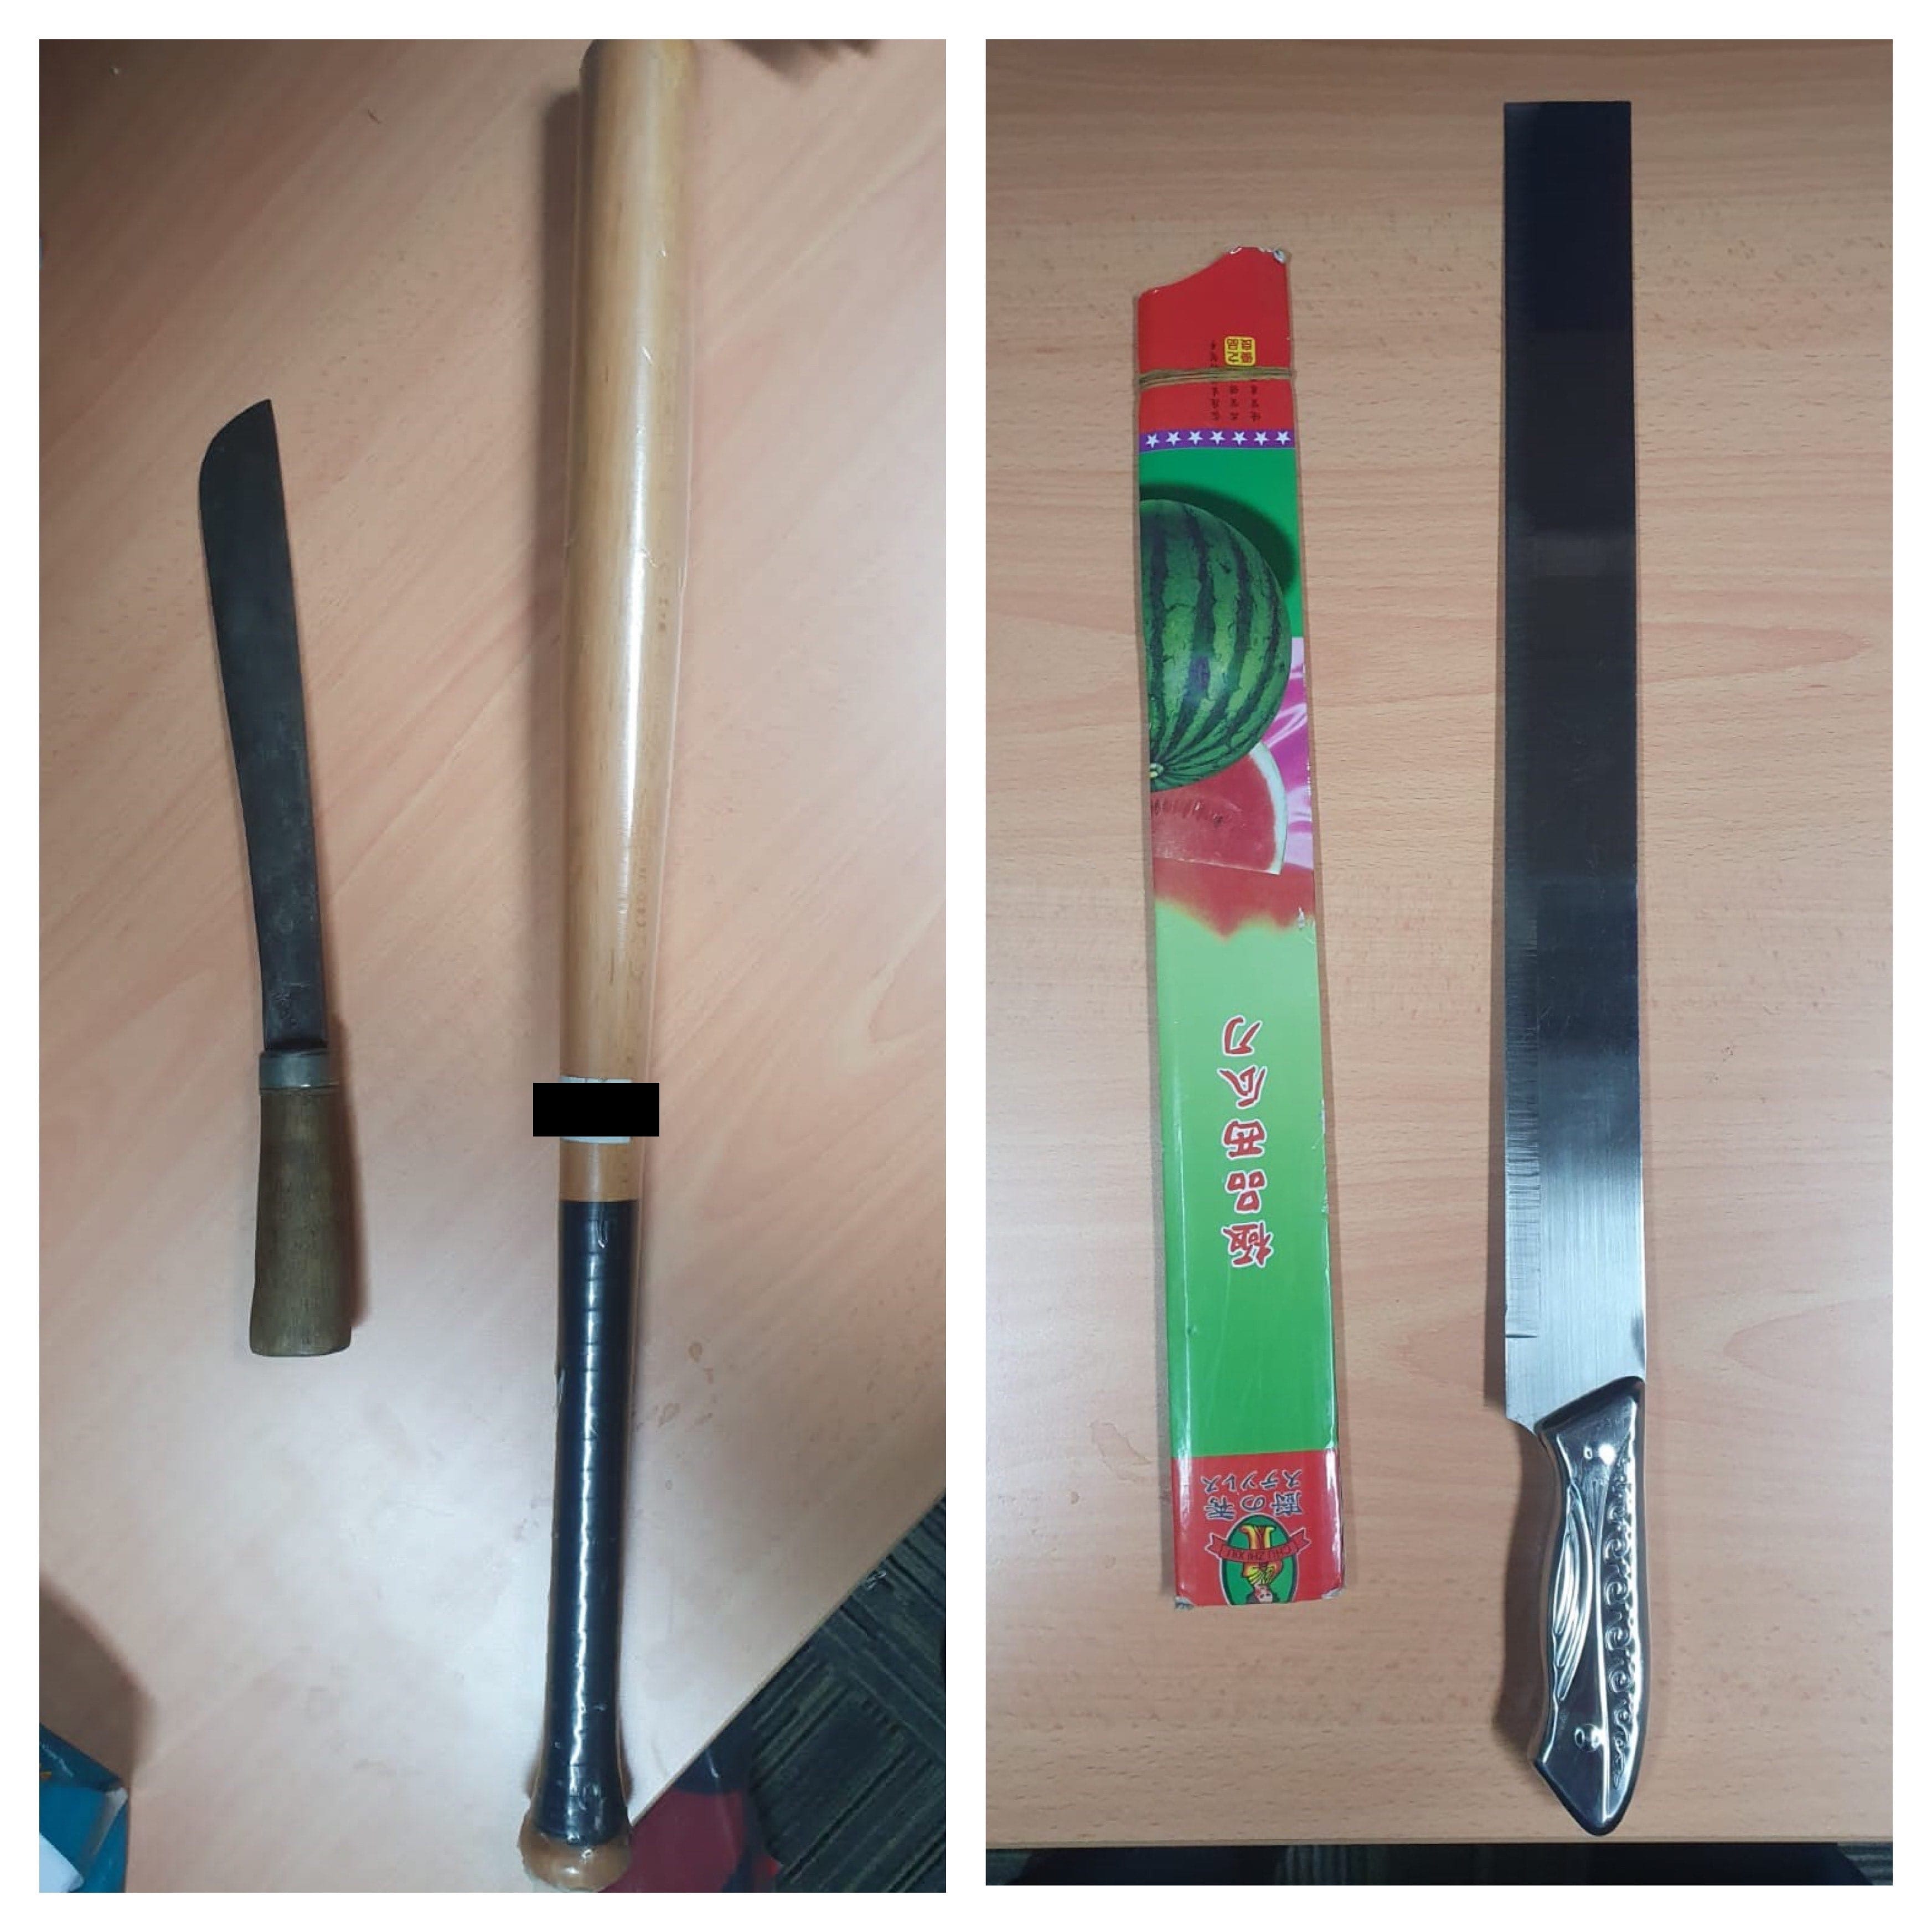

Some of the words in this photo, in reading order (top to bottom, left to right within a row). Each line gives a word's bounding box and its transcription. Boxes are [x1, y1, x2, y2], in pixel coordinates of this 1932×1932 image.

[1217, 1015, 1274, 1268] 極品西瓜刀
